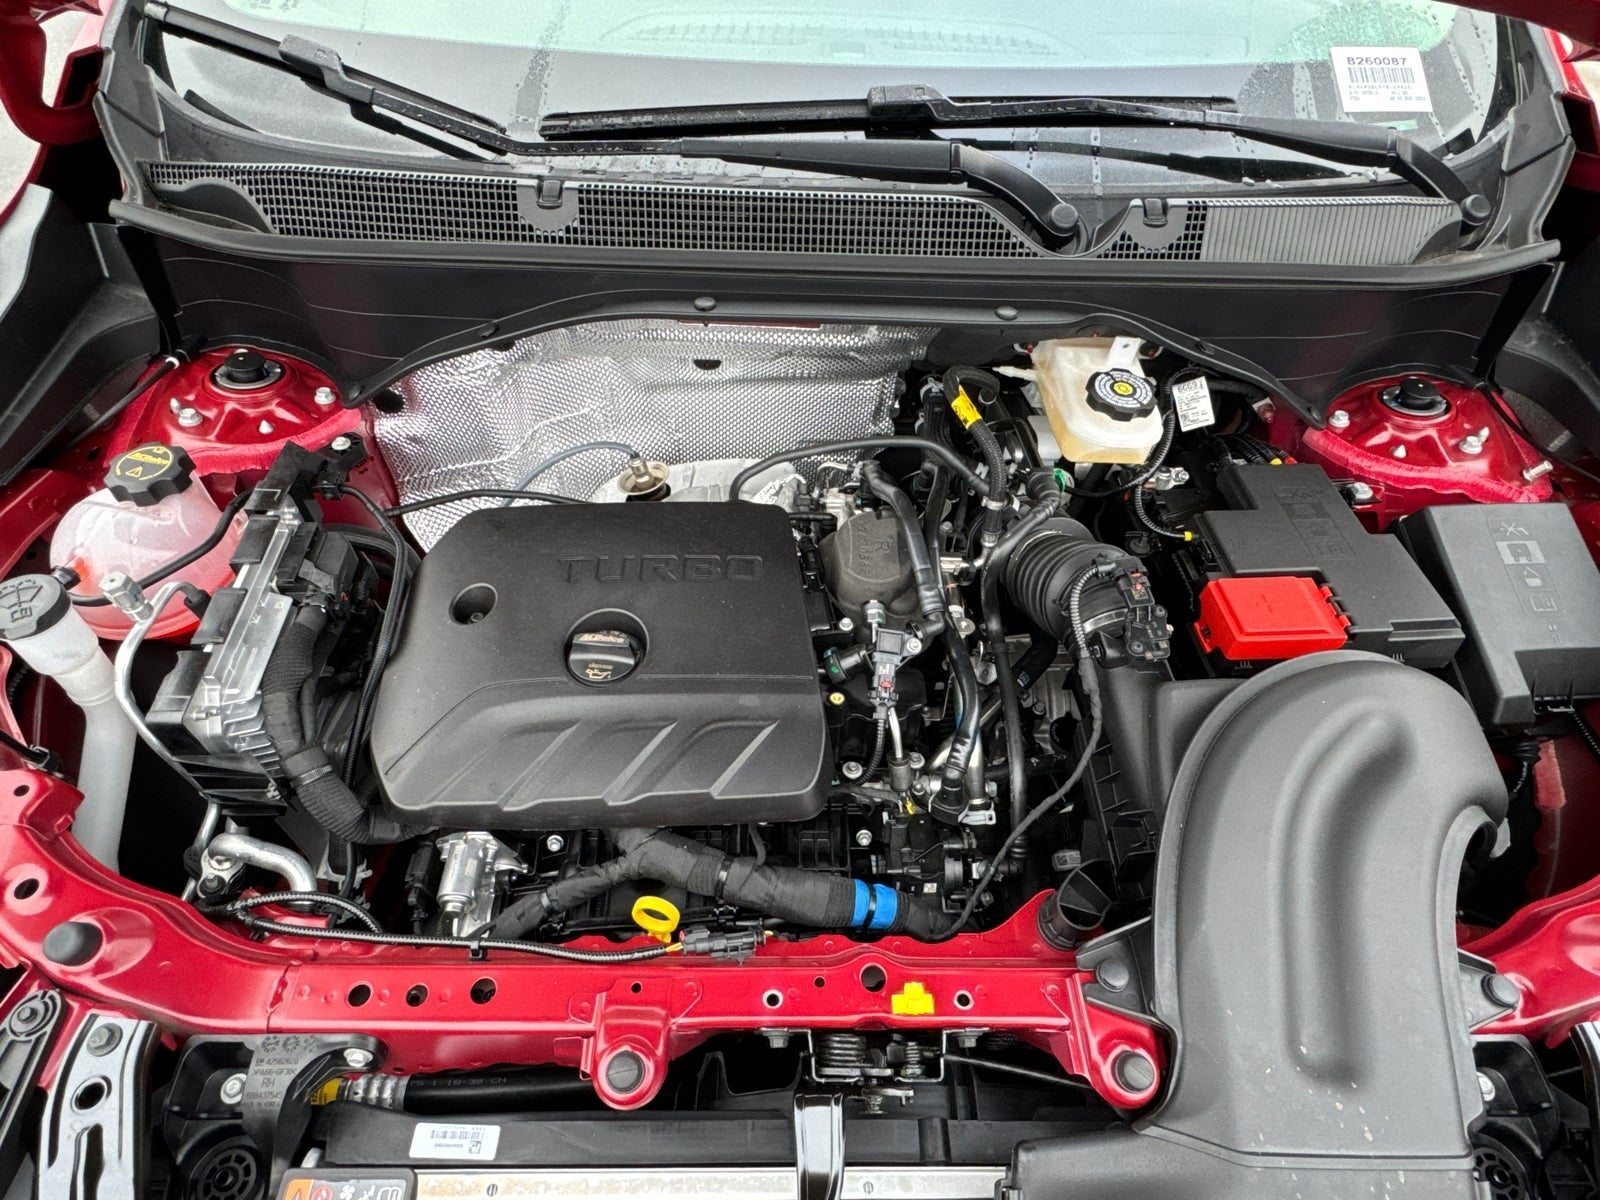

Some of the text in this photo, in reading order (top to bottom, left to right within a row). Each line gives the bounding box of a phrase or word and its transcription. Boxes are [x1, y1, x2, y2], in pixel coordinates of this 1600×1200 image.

[1346, 57, 1407, 66] B260087
[557, 554, 764, 583] TURBO
[261, 1077, 276, 1088] RH
